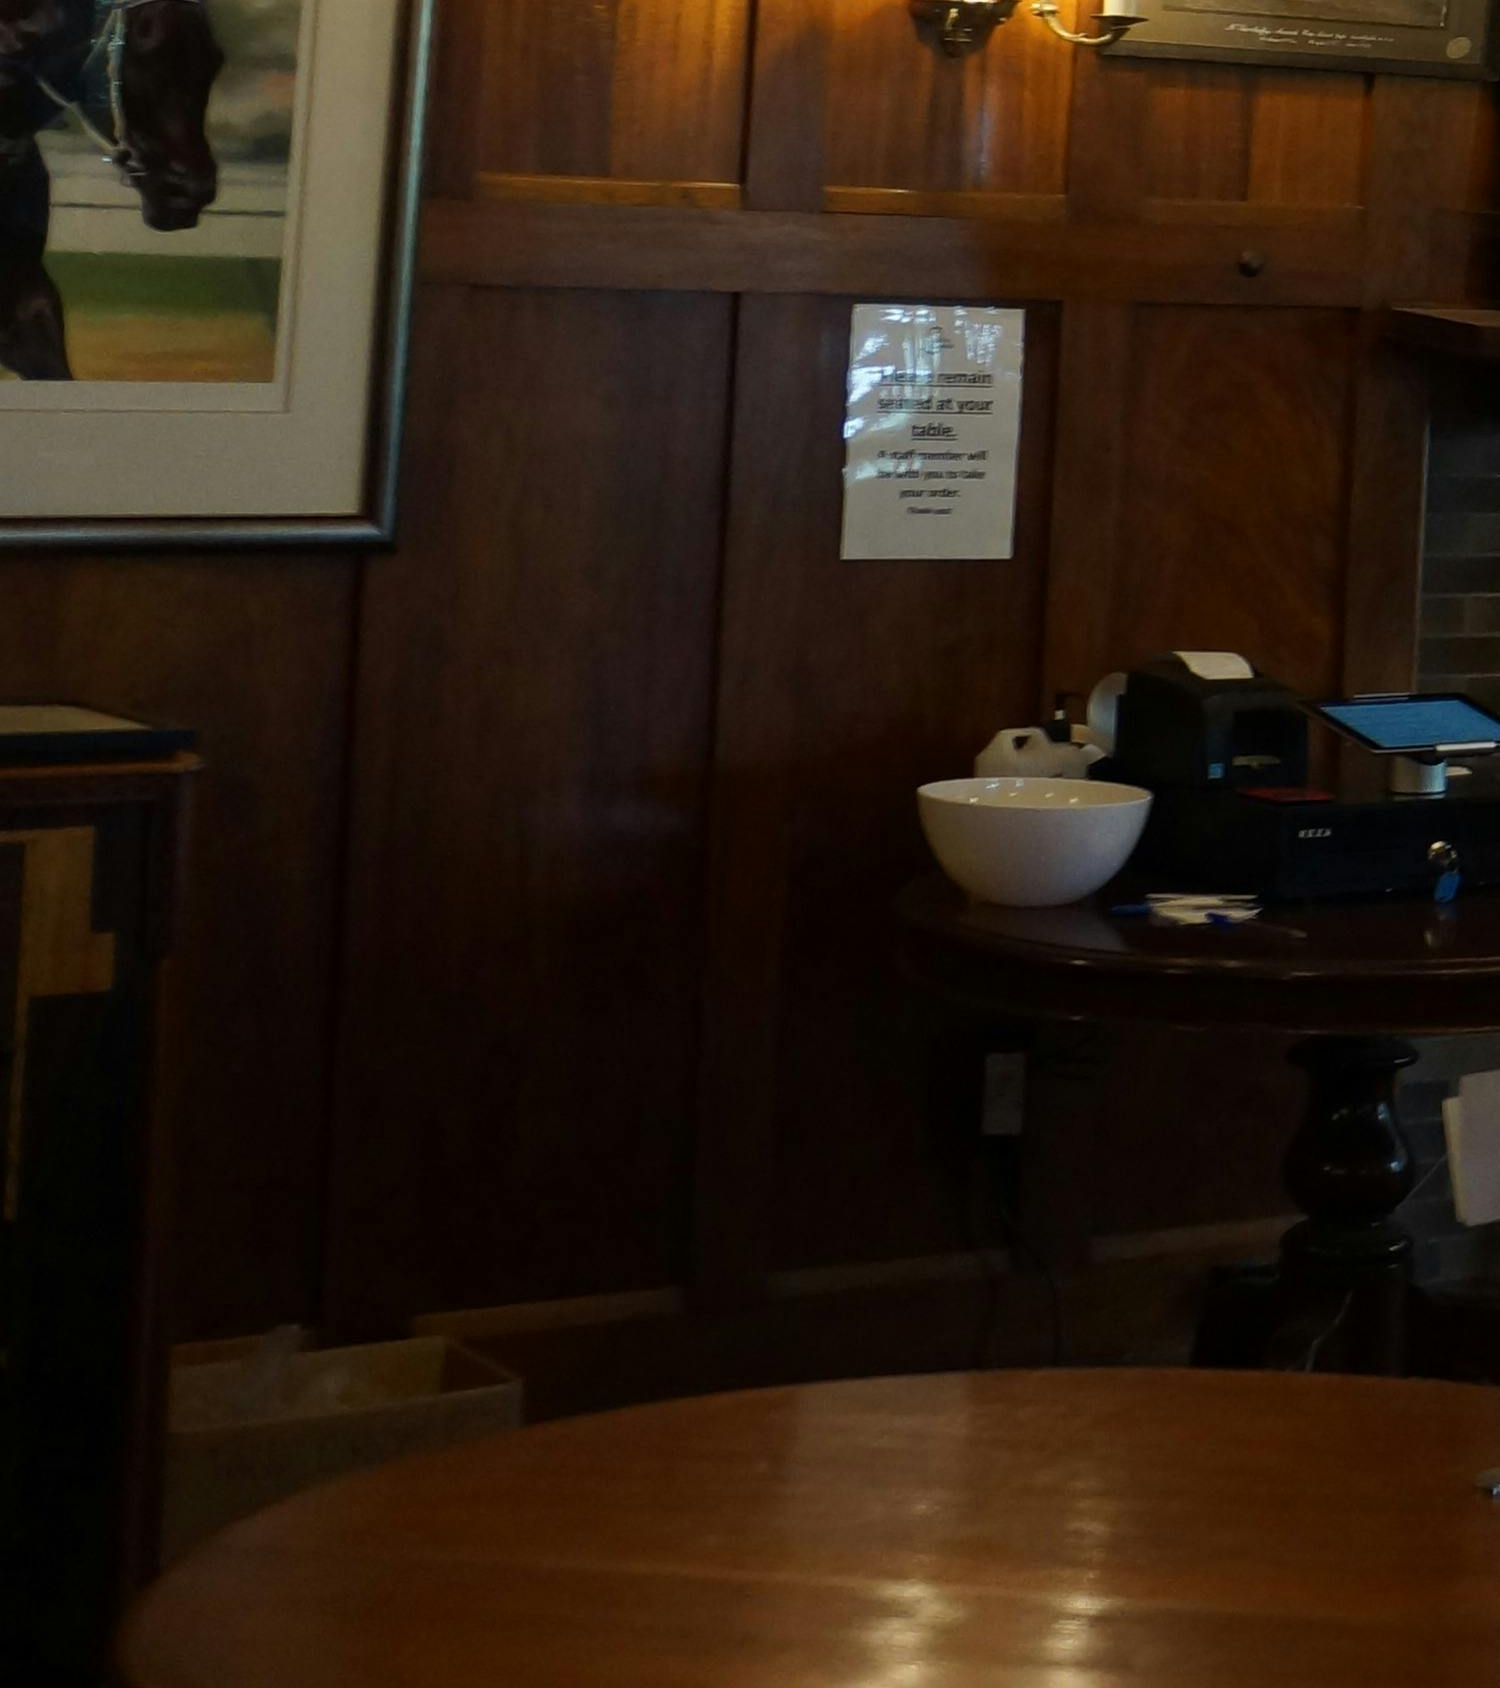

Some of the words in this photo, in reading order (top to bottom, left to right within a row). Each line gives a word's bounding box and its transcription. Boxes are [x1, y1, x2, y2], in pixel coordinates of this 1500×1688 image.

[938, 370, 993, 385] remain
[877, 395, 933, 411] seaed
[955, 400, 995, 414] your
